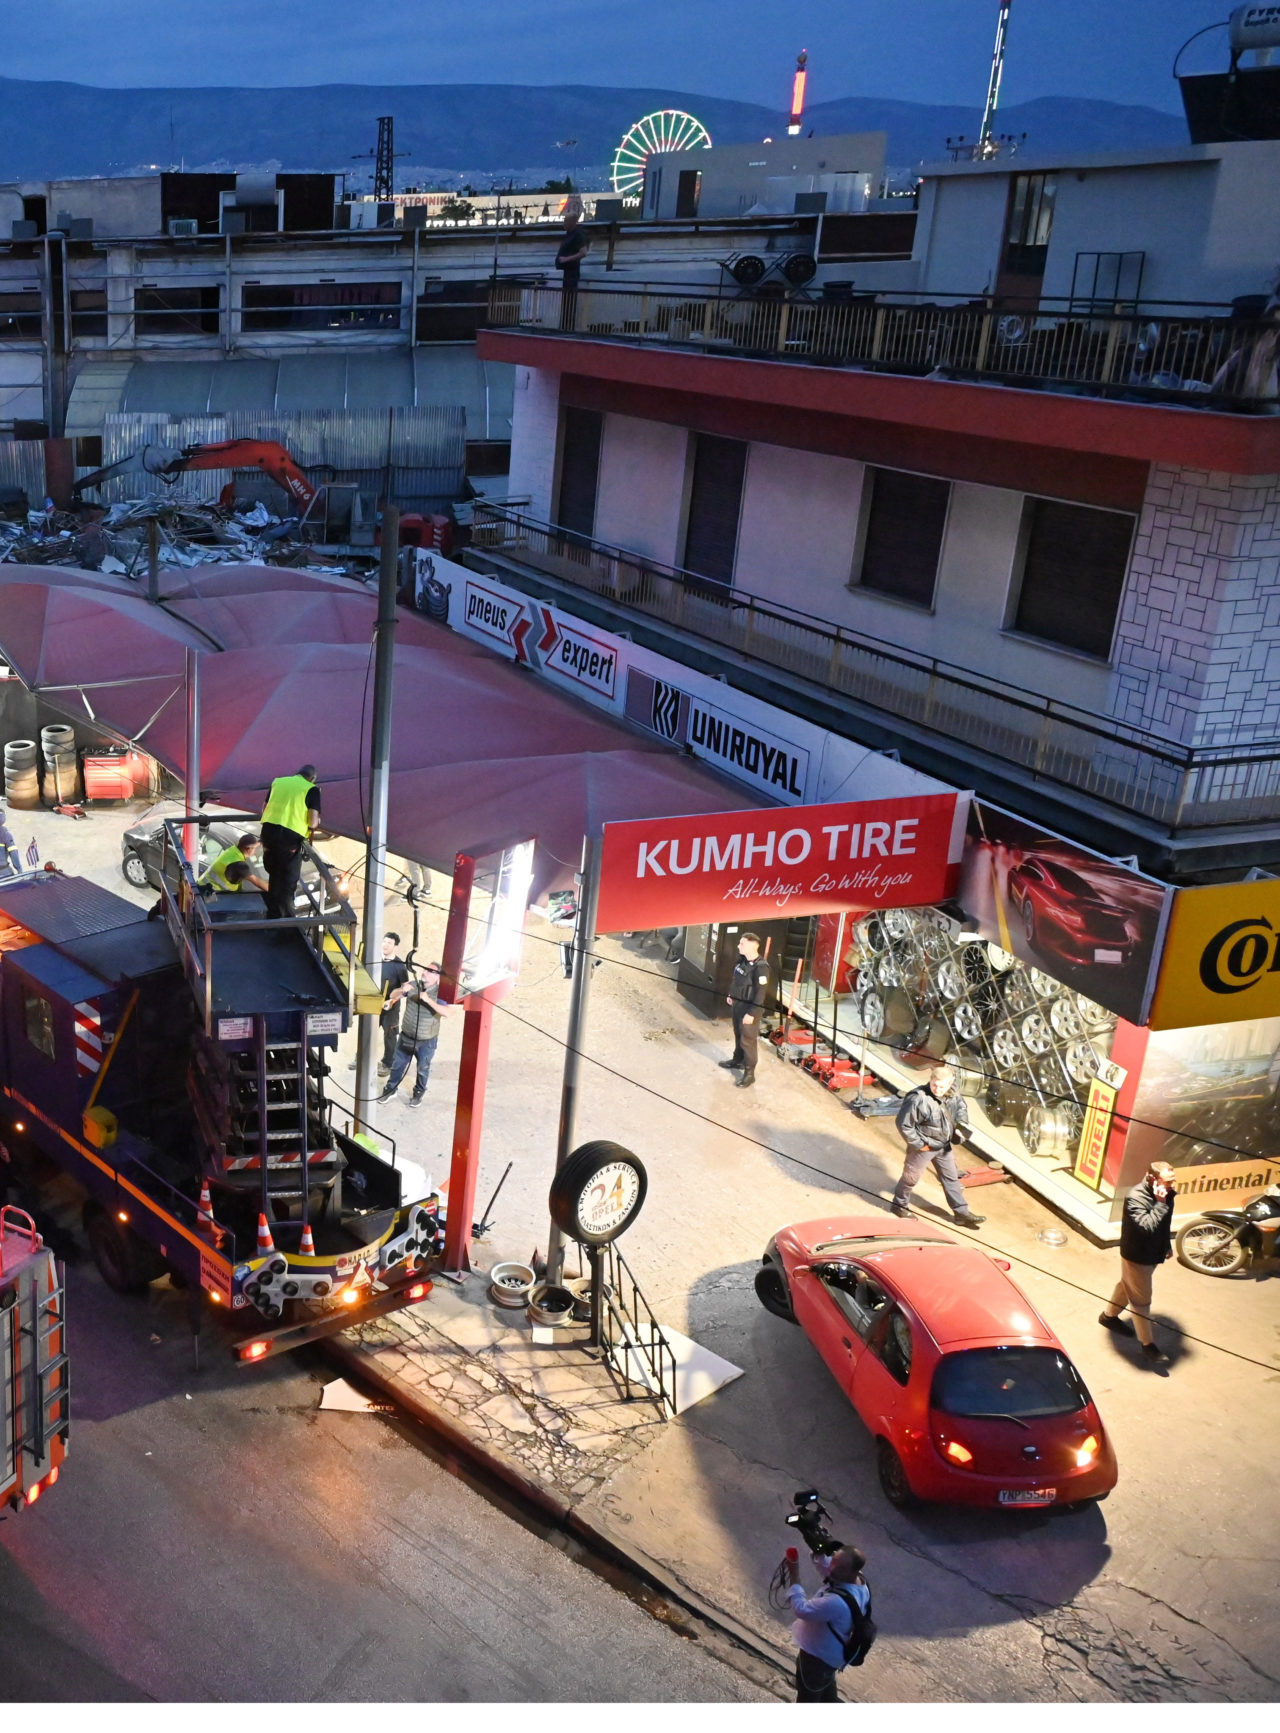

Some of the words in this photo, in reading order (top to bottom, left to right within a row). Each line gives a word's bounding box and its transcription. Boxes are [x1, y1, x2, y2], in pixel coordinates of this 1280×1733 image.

[466, 590, 508, 631] pneus
[560, 639, 615, 685] expert
[691, 708, 803, 797] UNIROYAL
[636, 828, 812, 878] KUMHO
[821, 818, 919, 861] TIRE
[722, 878, 803, 907] All-Ways,
[874, 873, 912, 898] you
[1078, 1087, 1112, 1181] PIRELLI
[1176, 1168, 1272, 1195] ntinental
